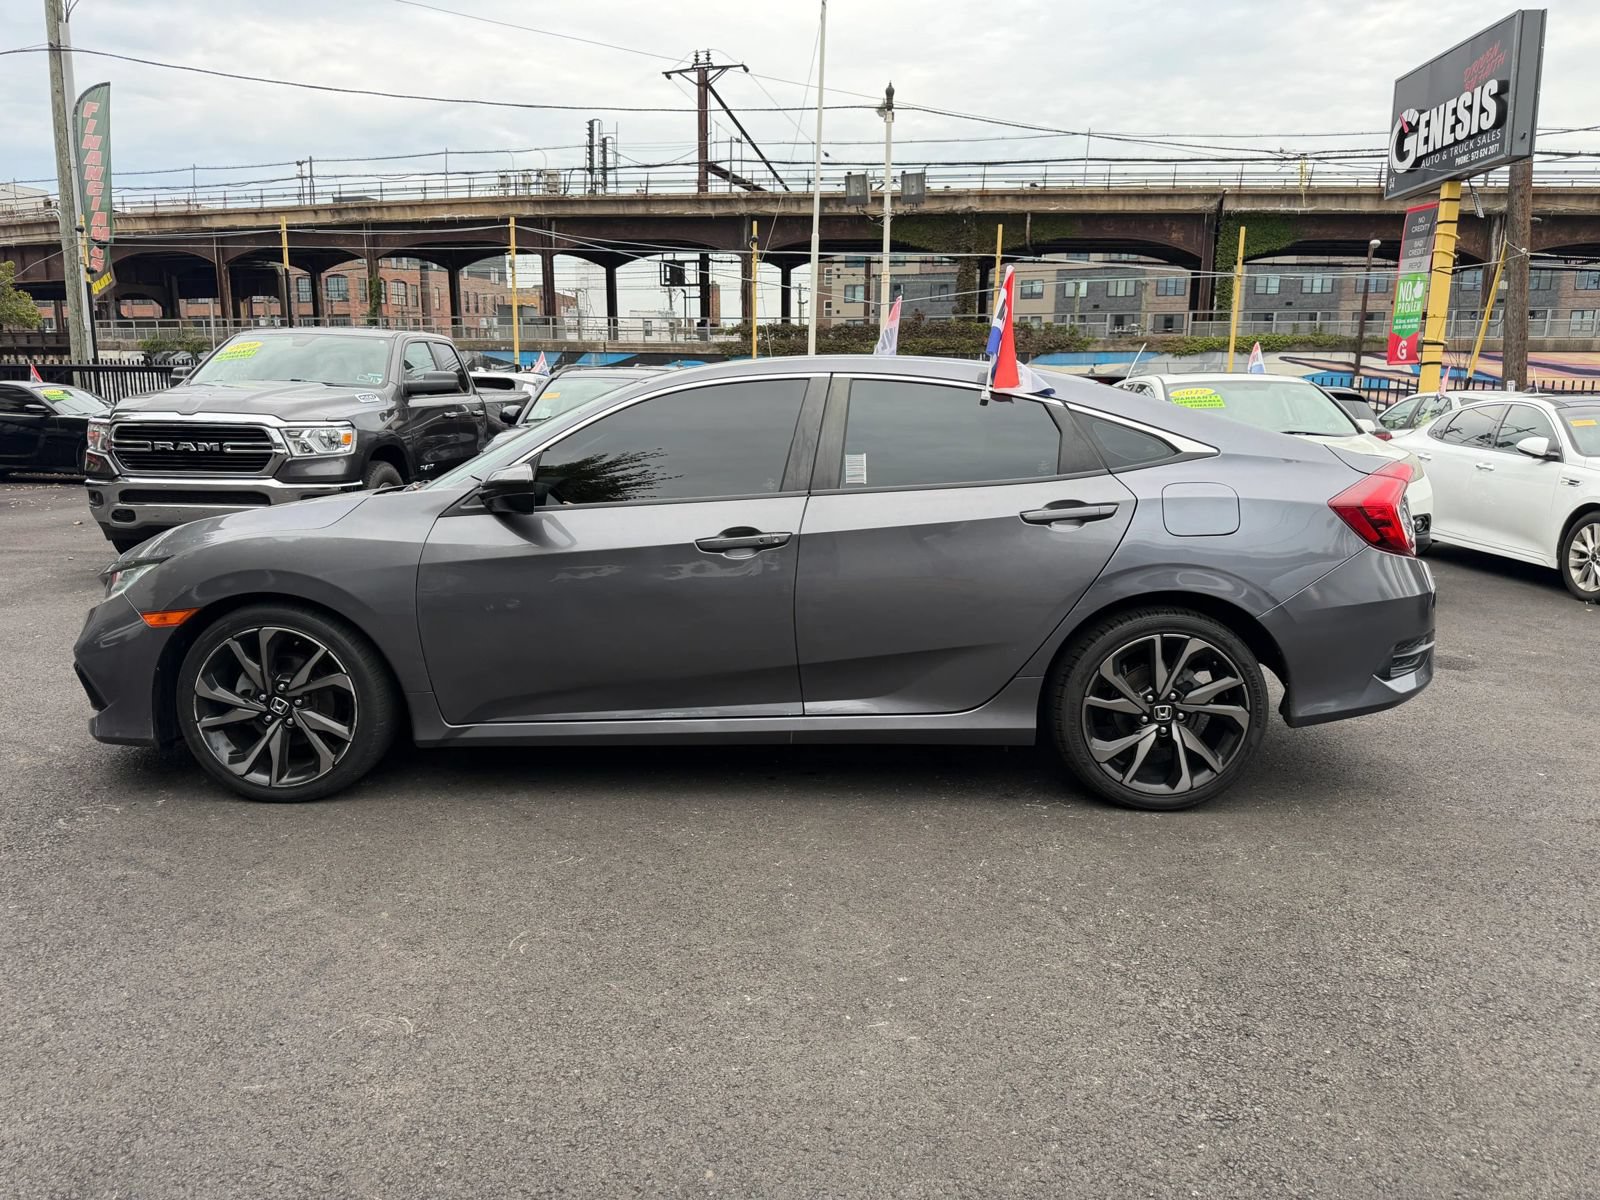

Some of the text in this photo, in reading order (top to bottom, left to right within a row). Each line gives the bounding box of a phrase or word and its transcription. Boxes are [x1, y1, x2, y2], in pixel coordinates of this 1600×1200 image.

[1388, 79, 1498, 174] GENESIS
[1420, 128, 1501, 169] AUTO & TRUCK SALES
[81, 101, 110, 273] FINANCIAMOS
[1397, 340, 1408, 360] G
[153, 441, 219, 452] RAM
